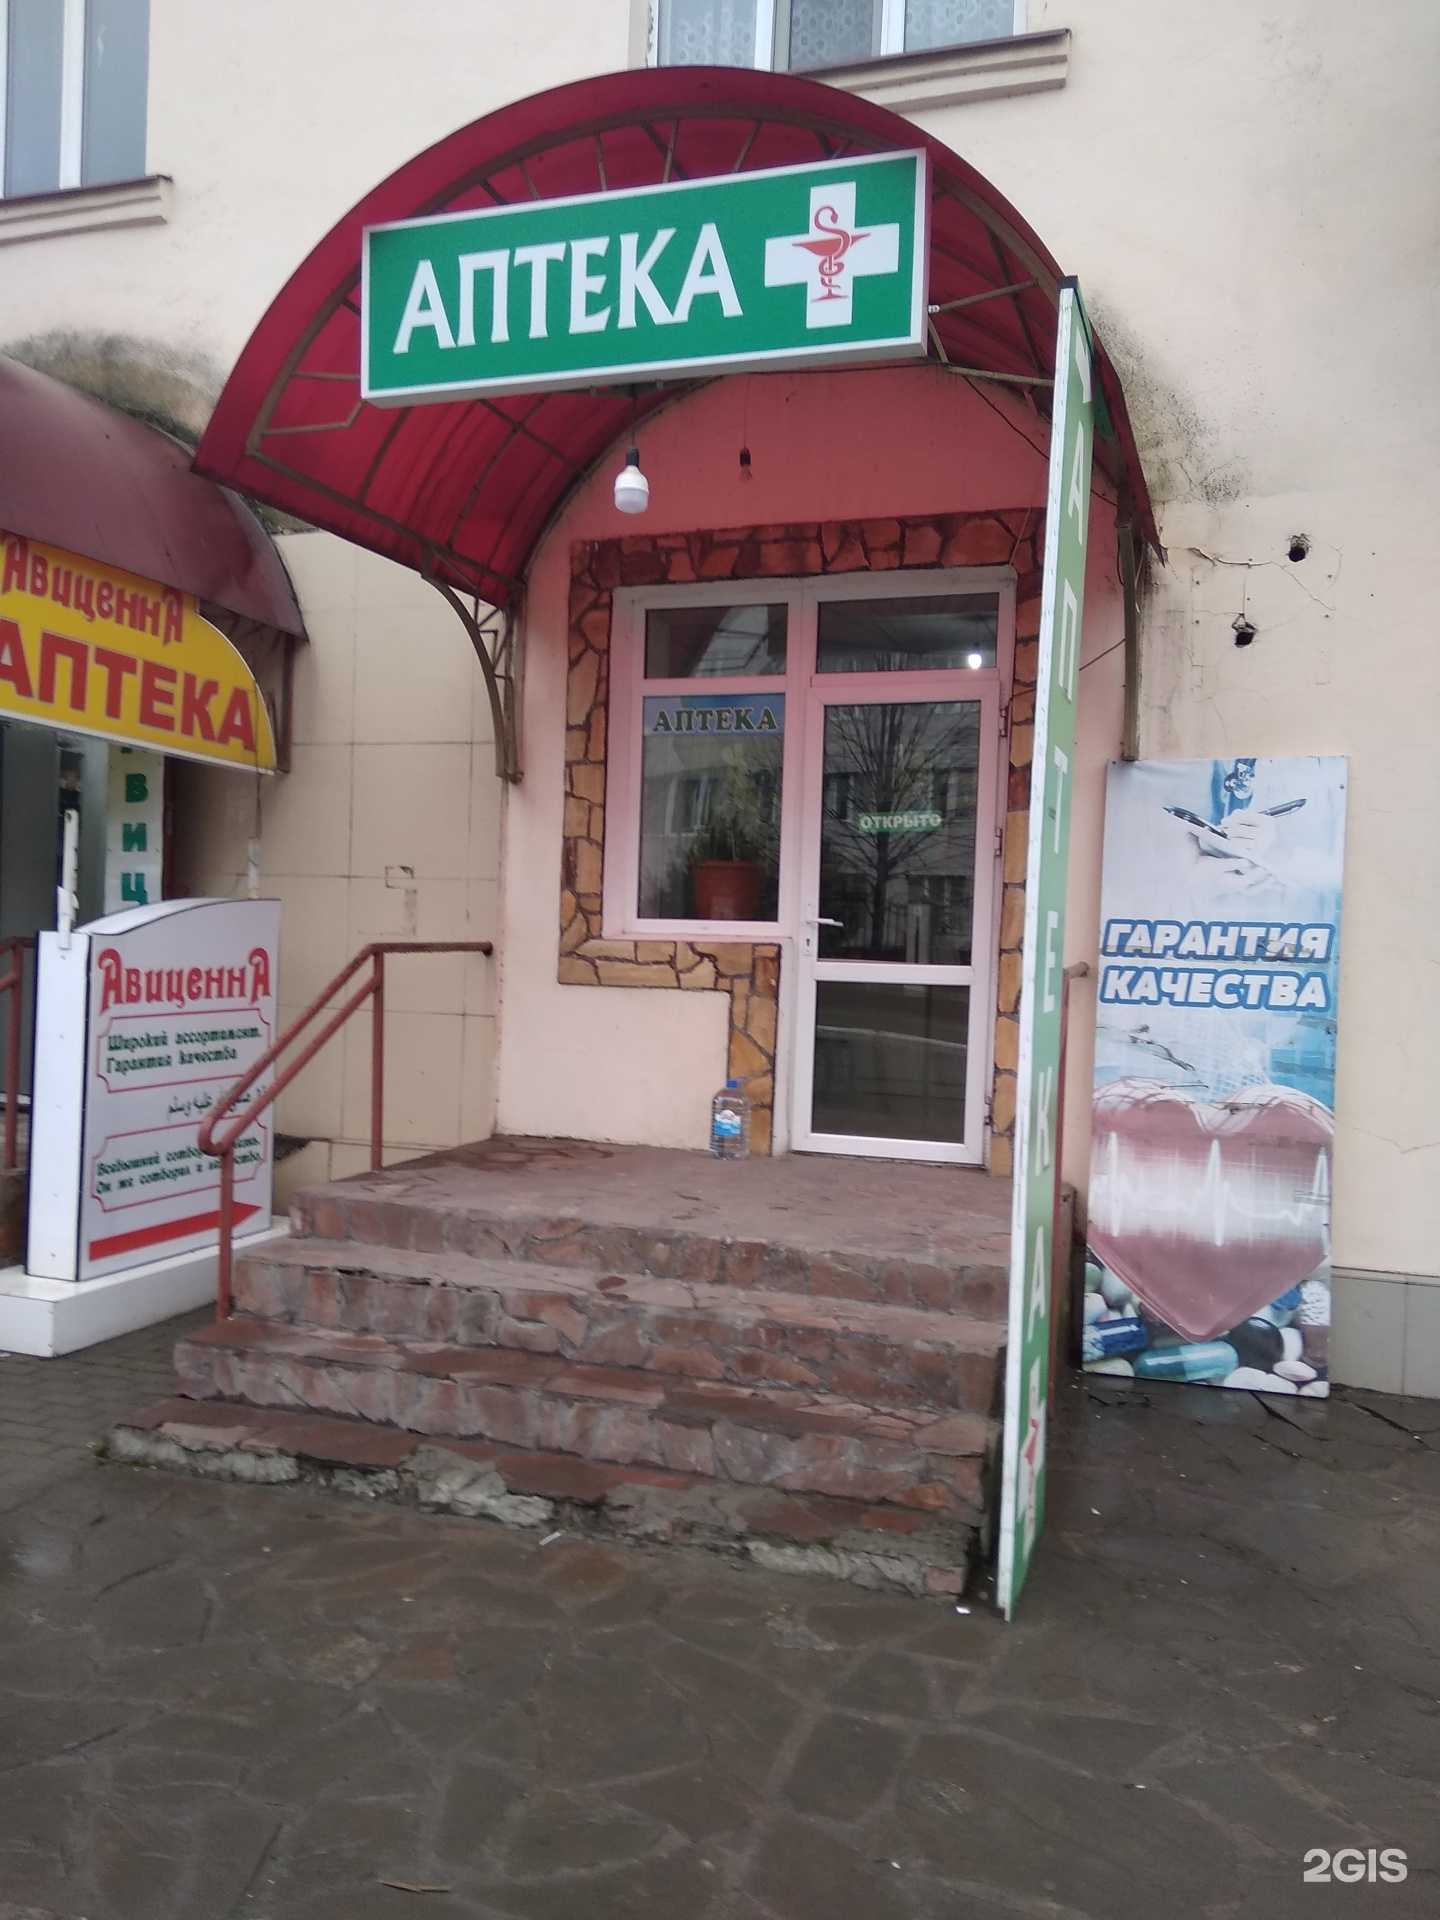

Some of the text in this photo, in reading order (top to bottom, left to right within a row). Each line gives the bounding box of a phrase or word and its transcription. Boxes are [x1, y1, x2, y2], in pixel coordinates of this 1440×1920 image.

[392, 222, 744, 354] АПТЕКА
[0, 616, 257, 752] АПТЕКА
[652, 706, 778, 733] АПТЕКА
[859, 812, 943, 830] ОТКРЫТО
[1027, 421, 1085, 1343] АПТЕКА
[1104, 921, 1333, 960] ГАРАНТИЯ
[1102, 967, 1330, 1009] КАЧЕСТВА
